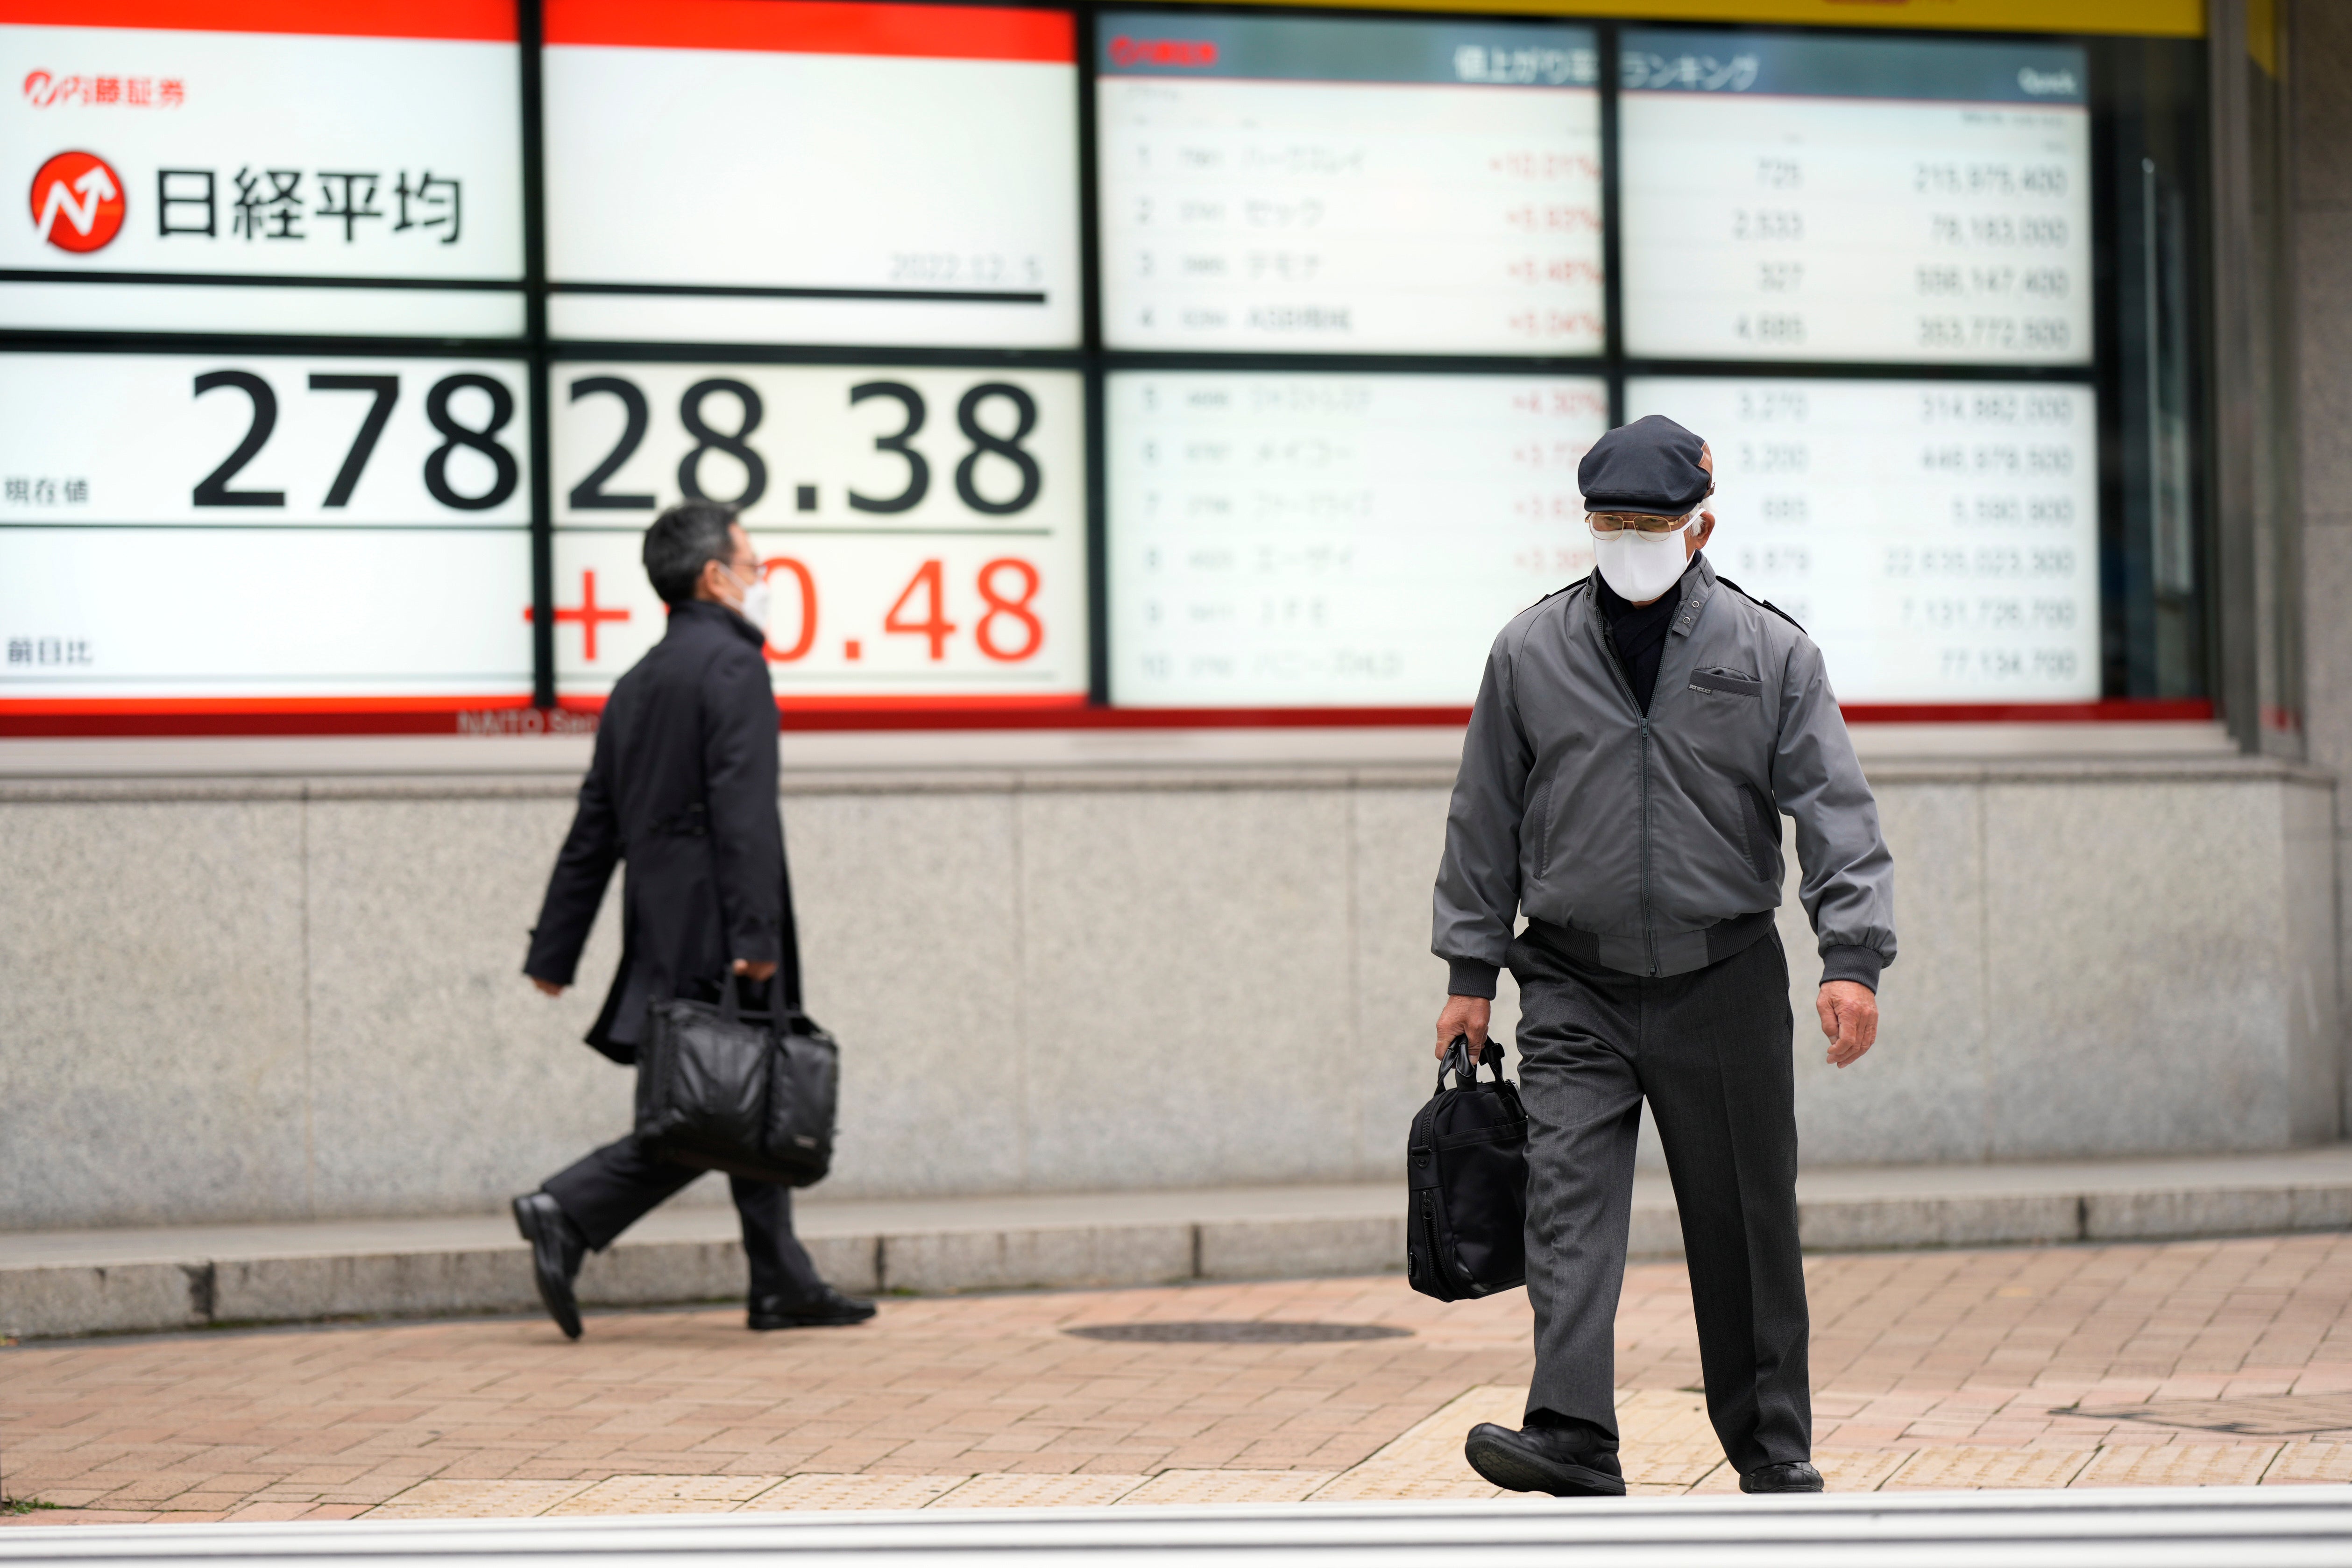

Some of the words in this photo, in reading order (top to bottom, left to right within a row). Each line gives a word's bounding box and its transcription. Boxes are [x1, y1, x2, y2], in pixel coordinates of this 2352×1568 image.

[156, 165, 463, 245] 日経平均
[4, 479, 89, 505] 現在値
[7, 636, 92, 666] 前日比
[458, 711, 542, 736] NAITO
